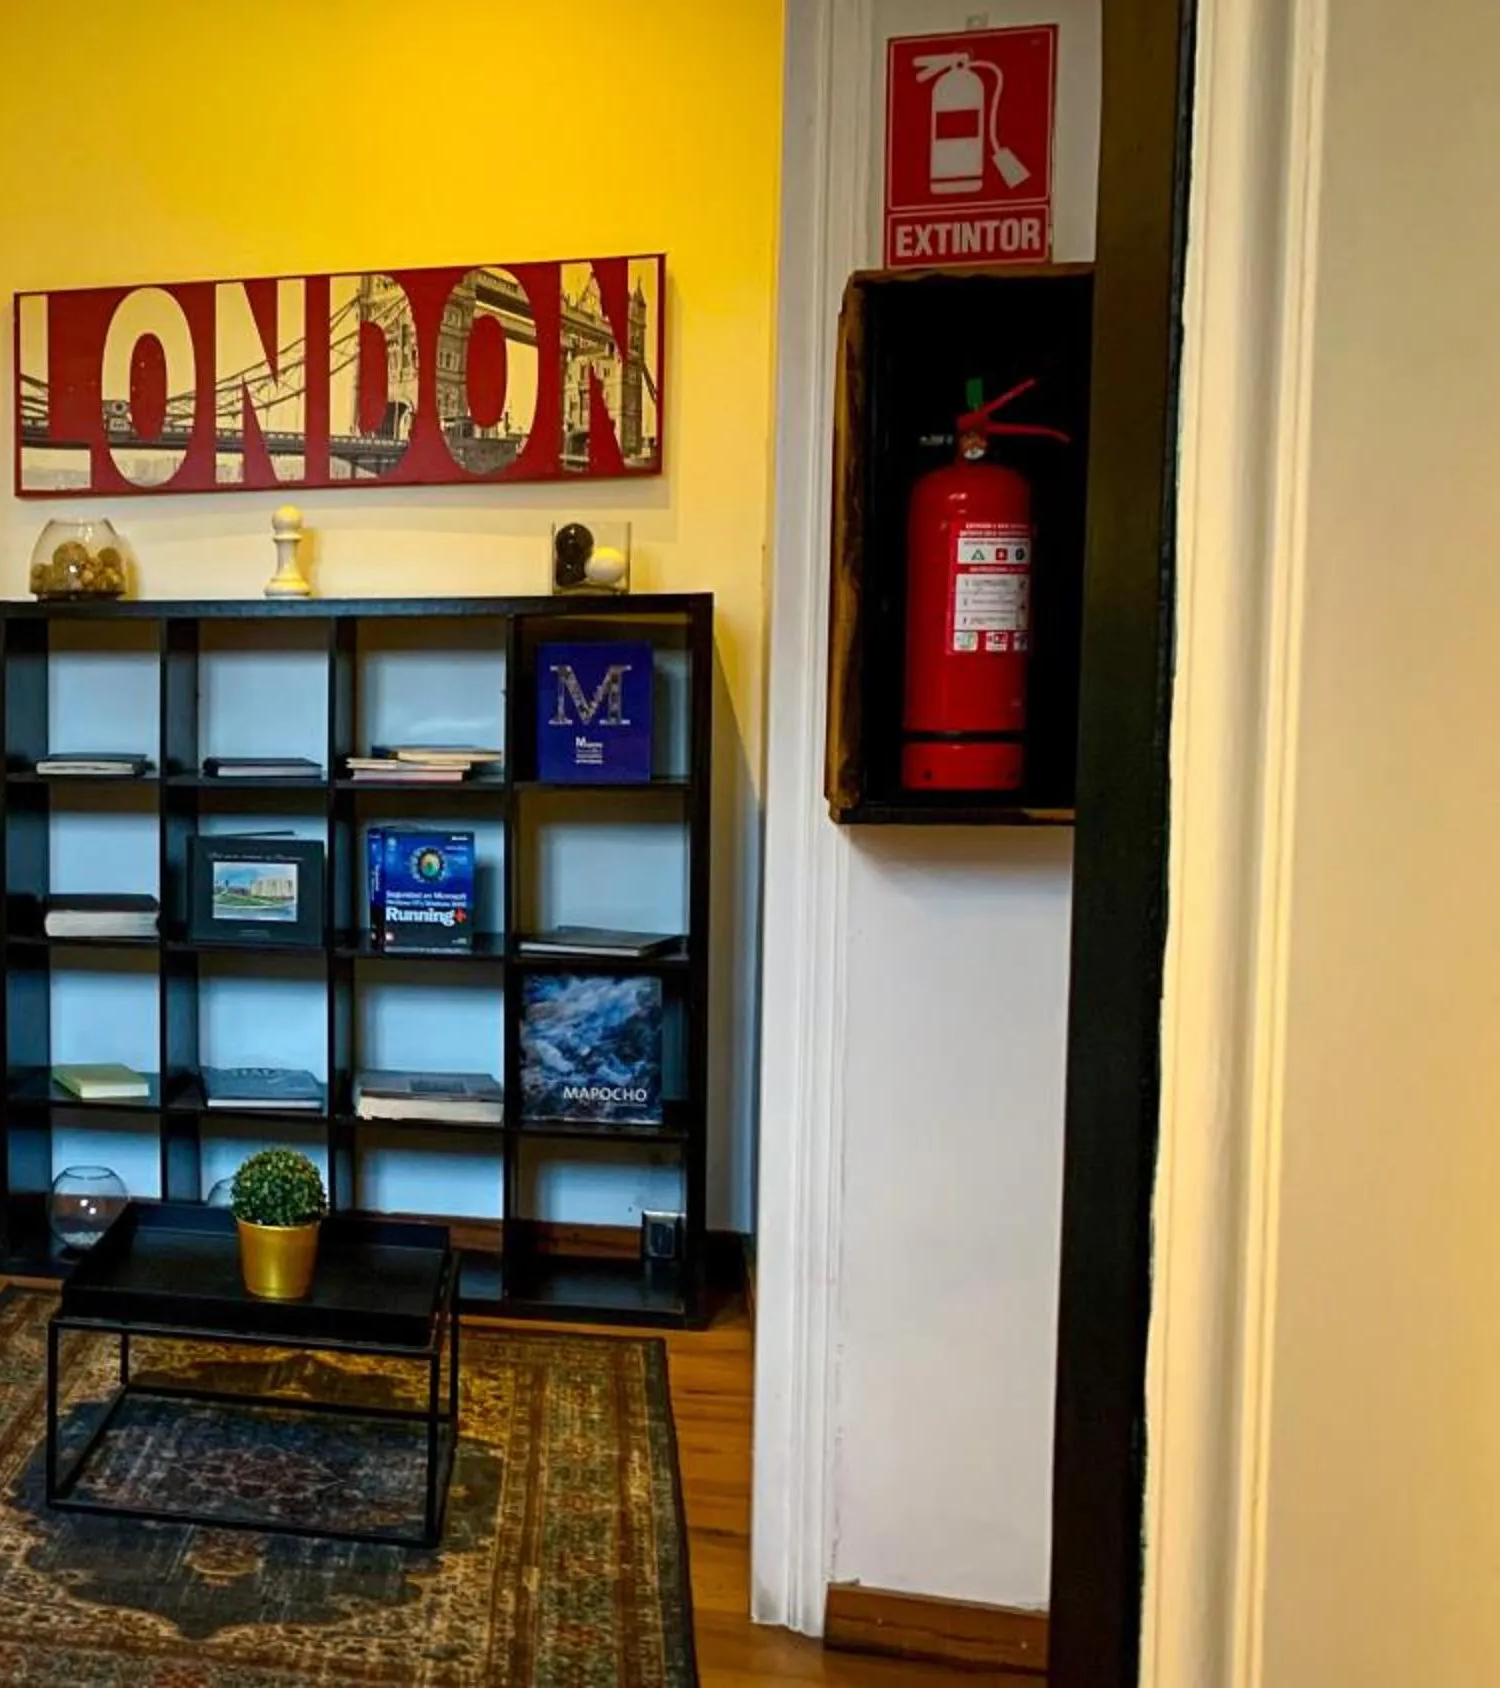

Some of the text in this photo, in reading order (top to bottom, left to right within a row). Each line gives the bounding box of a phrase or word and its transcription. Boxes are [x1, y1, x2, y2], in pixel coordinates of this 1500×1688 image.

[895, 217, 1041, 257] EXTINTOR
[19, 257, 659, 491] LONDON
[548, 664, 632, 725] M
[563, 1086, 647, 1102] MAPOCHO
